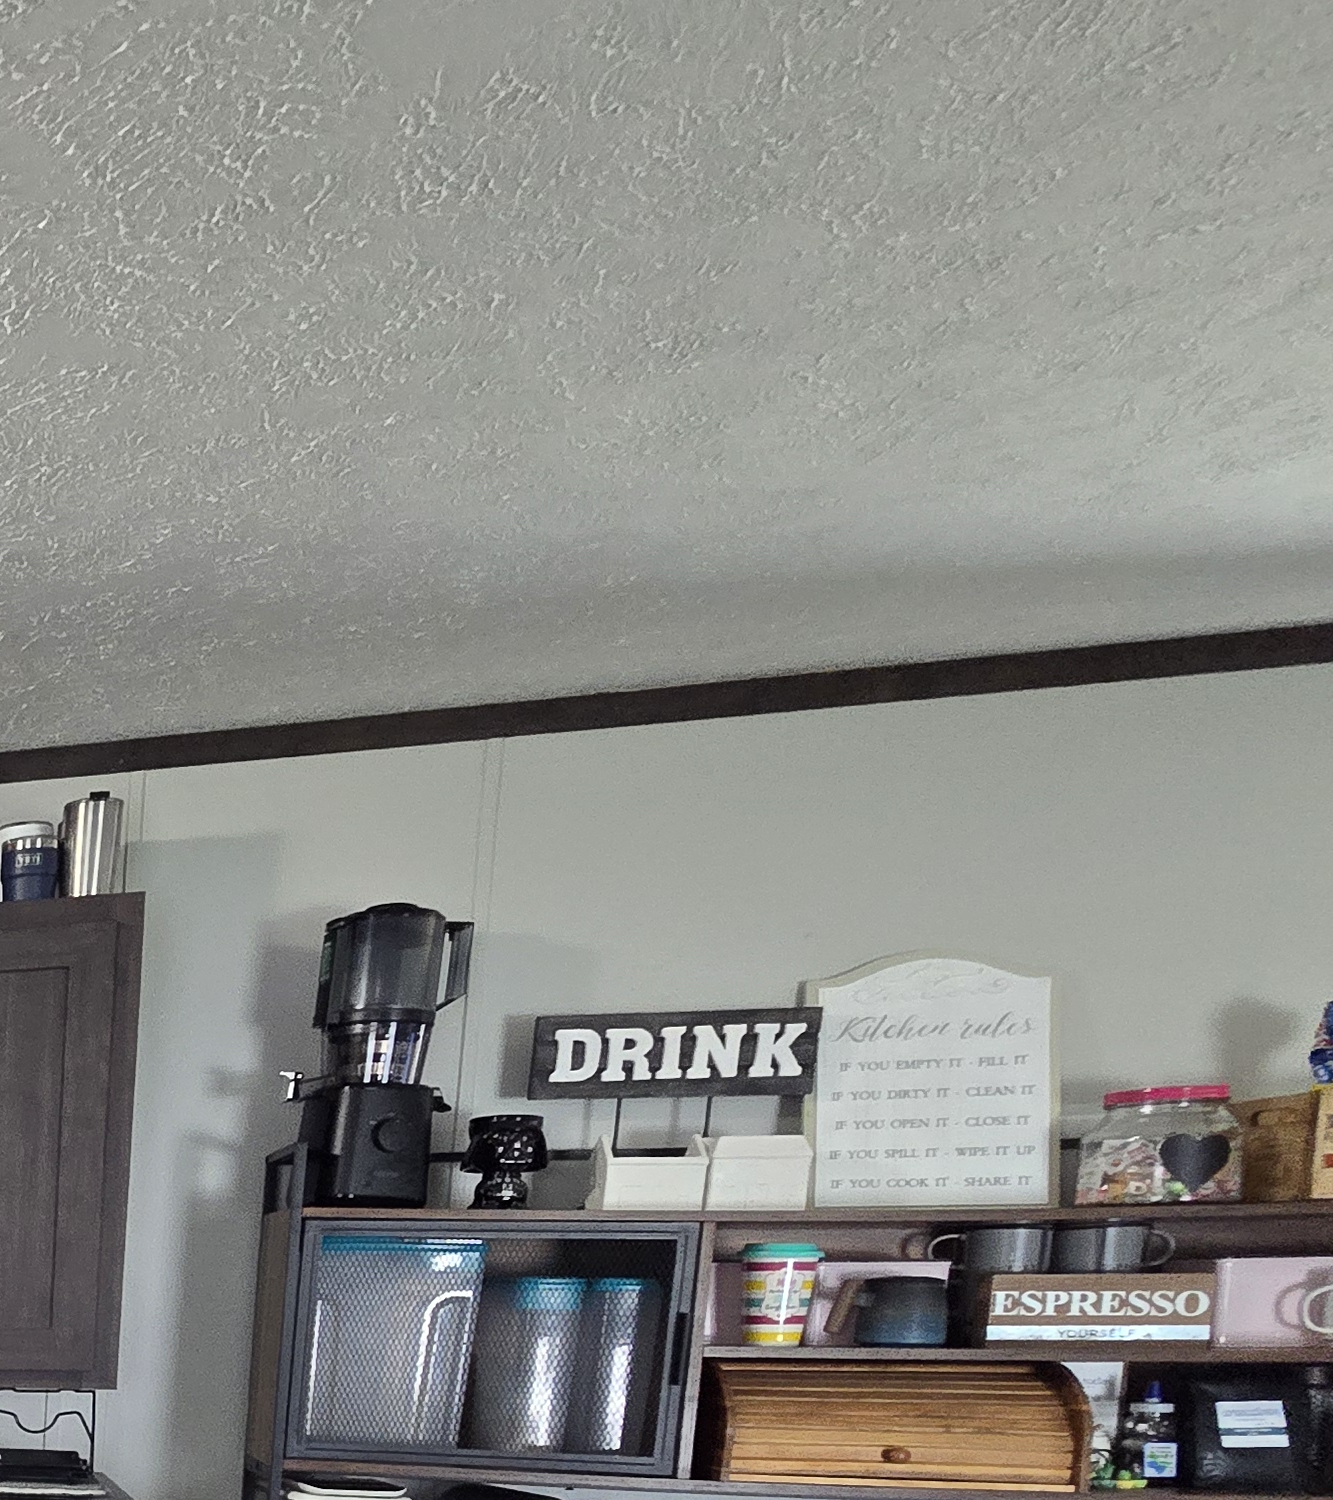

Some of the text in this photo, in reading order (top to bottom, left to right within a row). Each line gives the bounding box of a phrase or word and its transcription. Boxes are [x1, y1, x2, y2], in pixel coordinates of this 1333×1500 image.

[835, 1010, 1034, 1043] Kitchen rules
[548, 1022, 808, 1083] DRINK
[840, 1054, 1029, 1072] IF YOU EMPTY IT FILL IT
[833, 1085, 1035, 1101] IF YOU DIRTY IT CLEAN IT
[836, 1115, 1030, 1130] IF YOU OPEN IT CLOSE IT
[830, 1145, 1035, 1159] IF YOU SPILL IT WIPE IT UP
[830, 1175, 1032, 1189] IF YOU COOK IT SHARE IT
[991, 1289, 1211, 1317] ESPRESSO
[1057, 1328, 1136, 1339] YOURSELF
